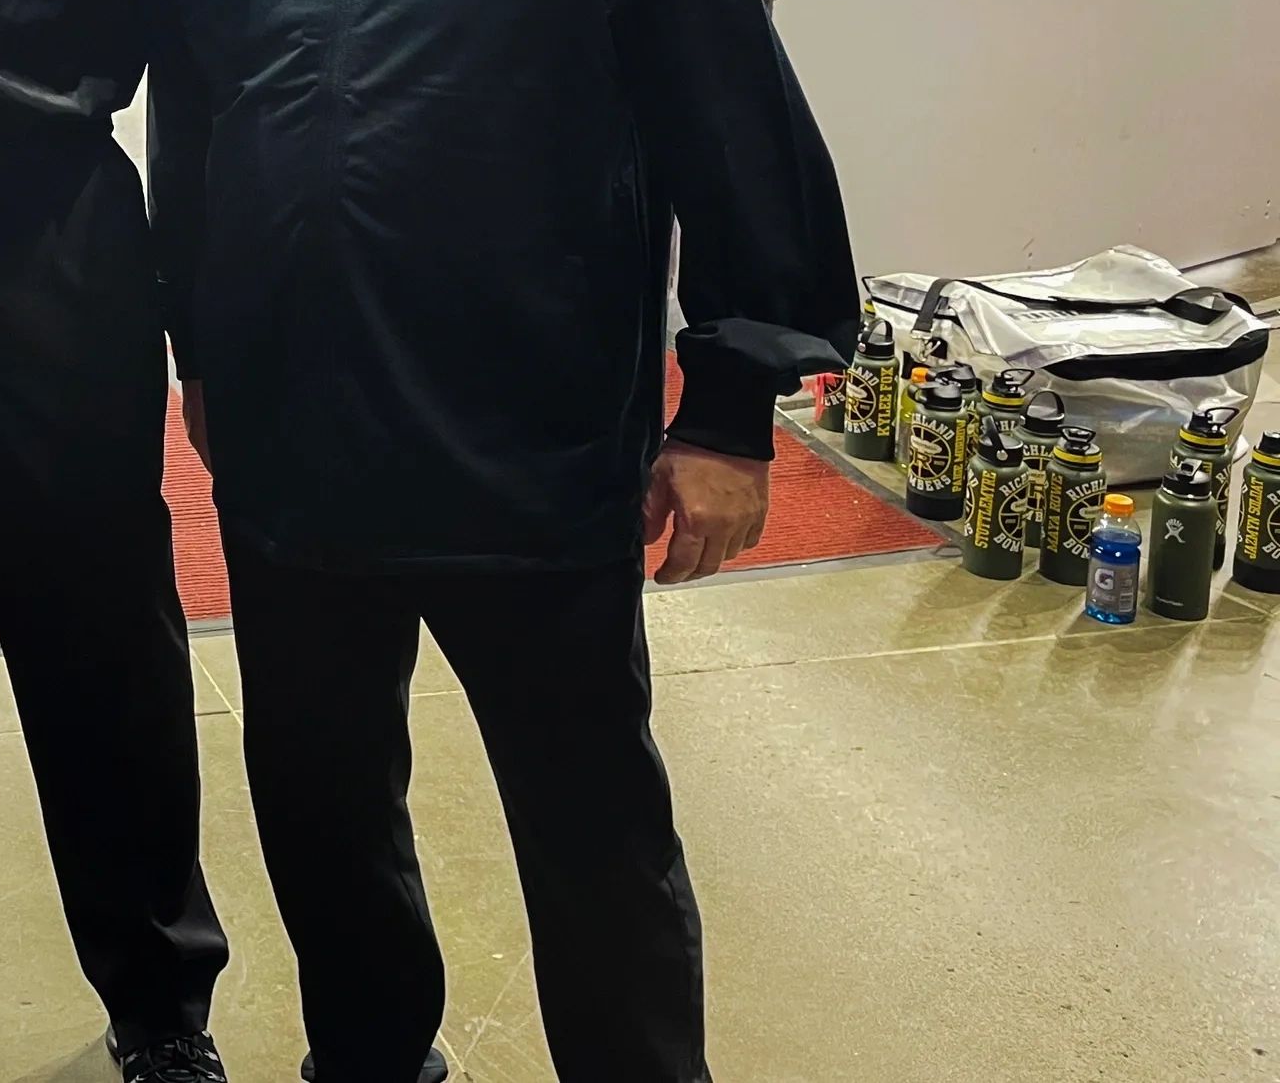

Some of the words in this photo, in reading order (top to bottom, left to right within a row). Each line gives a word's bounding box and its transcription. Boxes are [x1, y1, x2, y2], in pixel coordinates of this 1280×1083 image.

[880, 367, 894, 391] FOX
[876, 394, 892, 437] KYLEE
[975, 470, 997, 549] STOTTLEMYRE
[1050, 473, 1063, 513] ROWE
[1047, 516, 1060, 554] MAYA
[1244, 515, 1260, 559] JAZMYN
